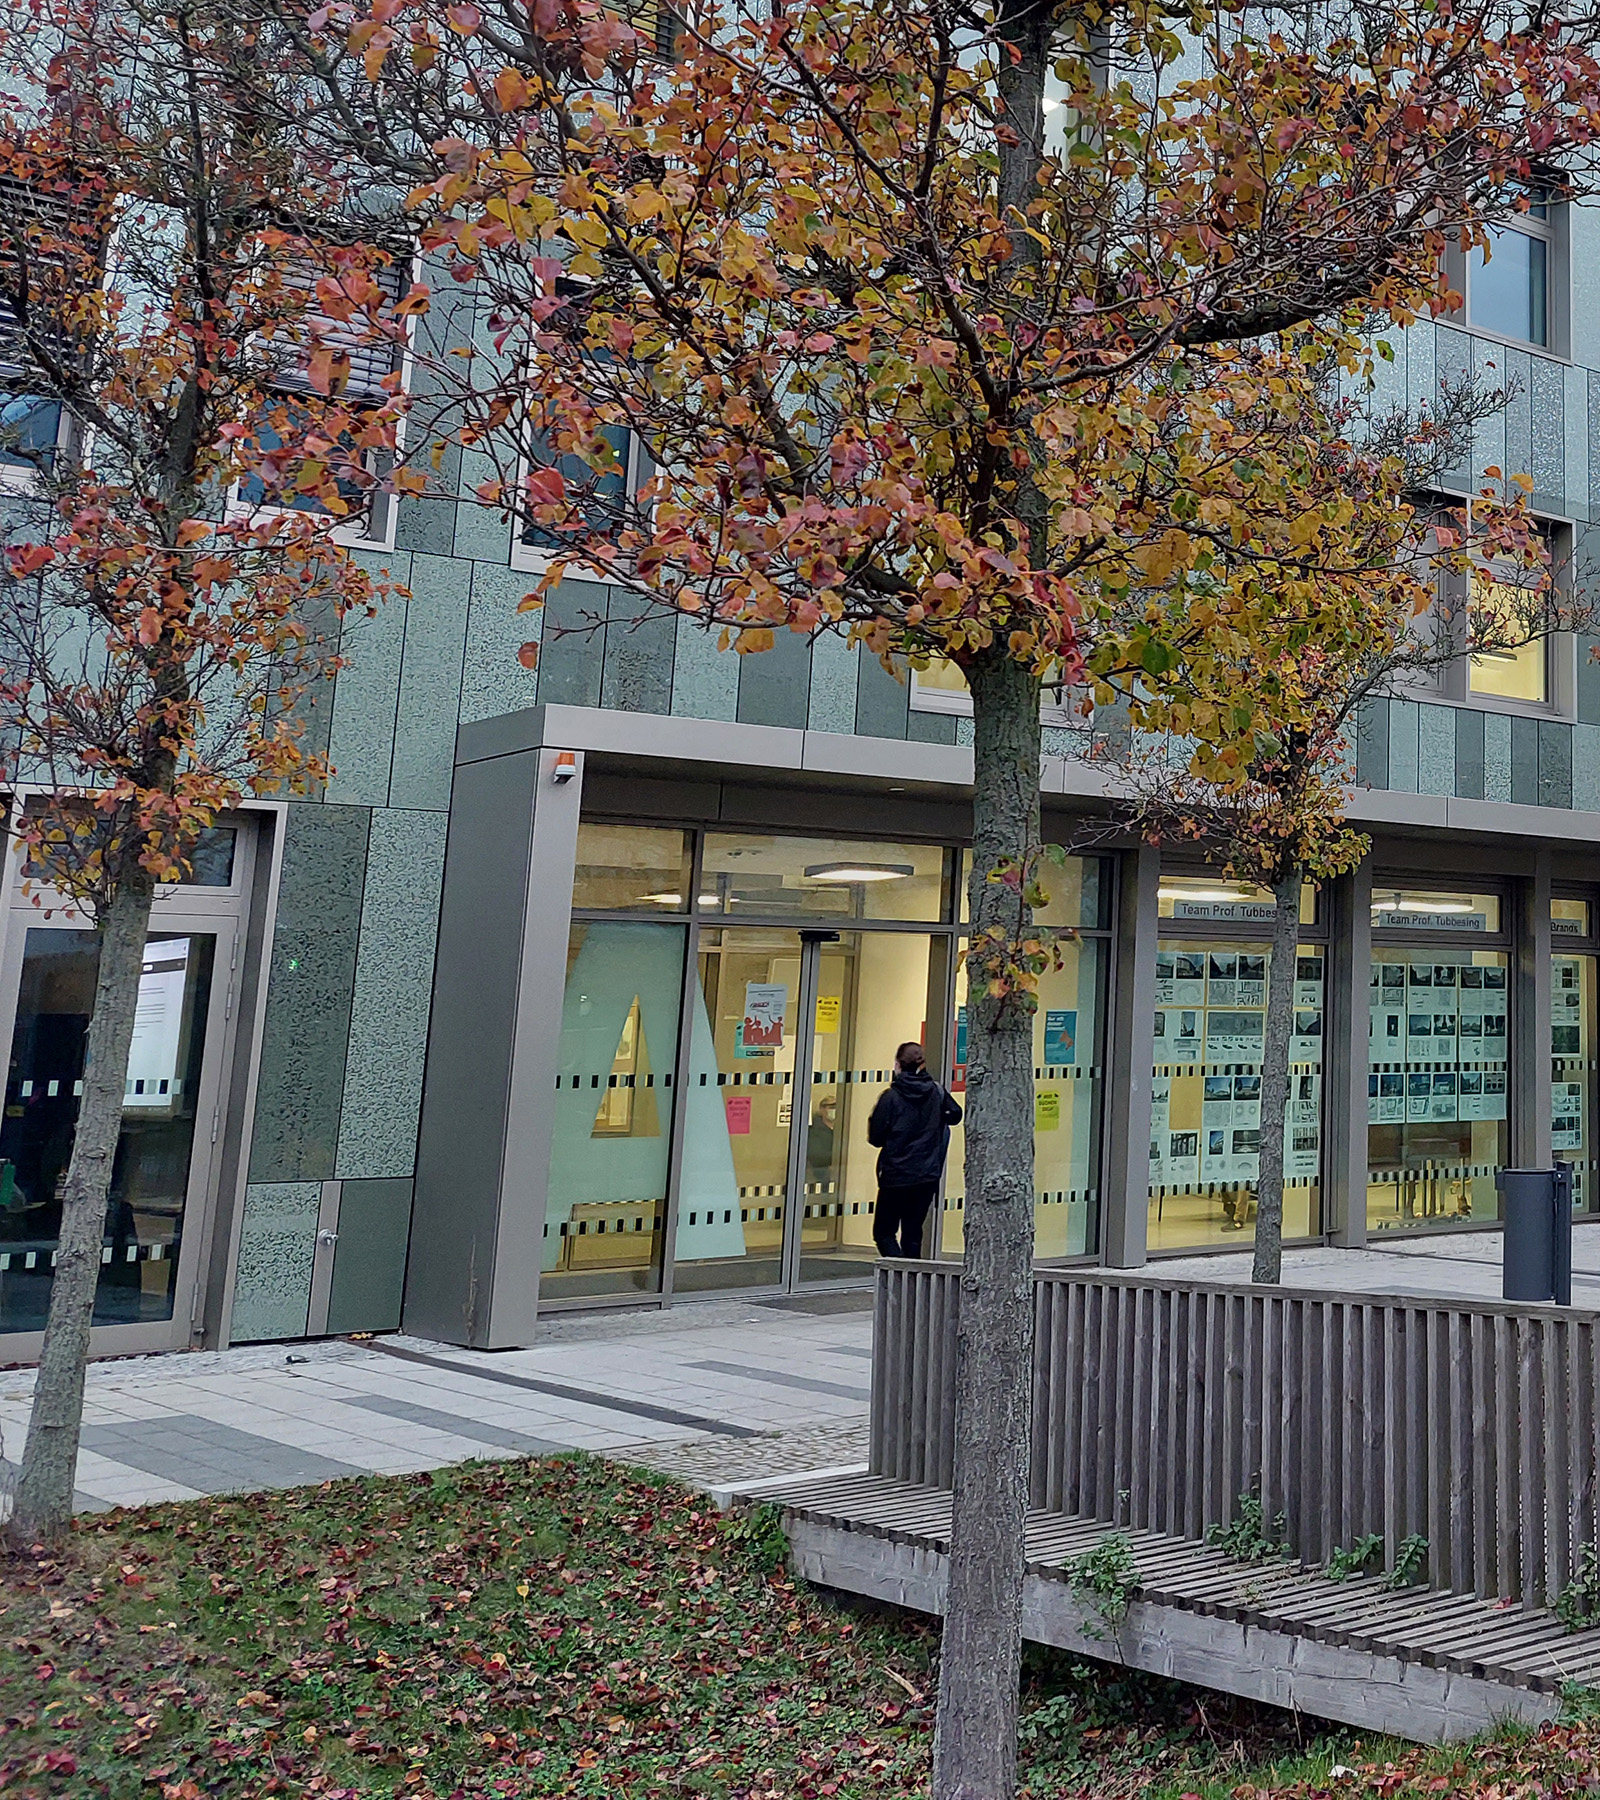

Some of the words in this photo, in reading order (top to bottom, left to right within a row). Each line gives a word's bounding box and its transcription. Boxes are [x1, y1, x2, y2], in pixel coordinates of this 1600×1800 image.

[1182, 903, 1209, 916] Team
[1240, 906, 1278, 919] Tubbes
[1386, 913, 1410, 925] Team
[1436, 916, 1480, 929] Tubbesing
[1551, 921, 1579, 934] Brands
